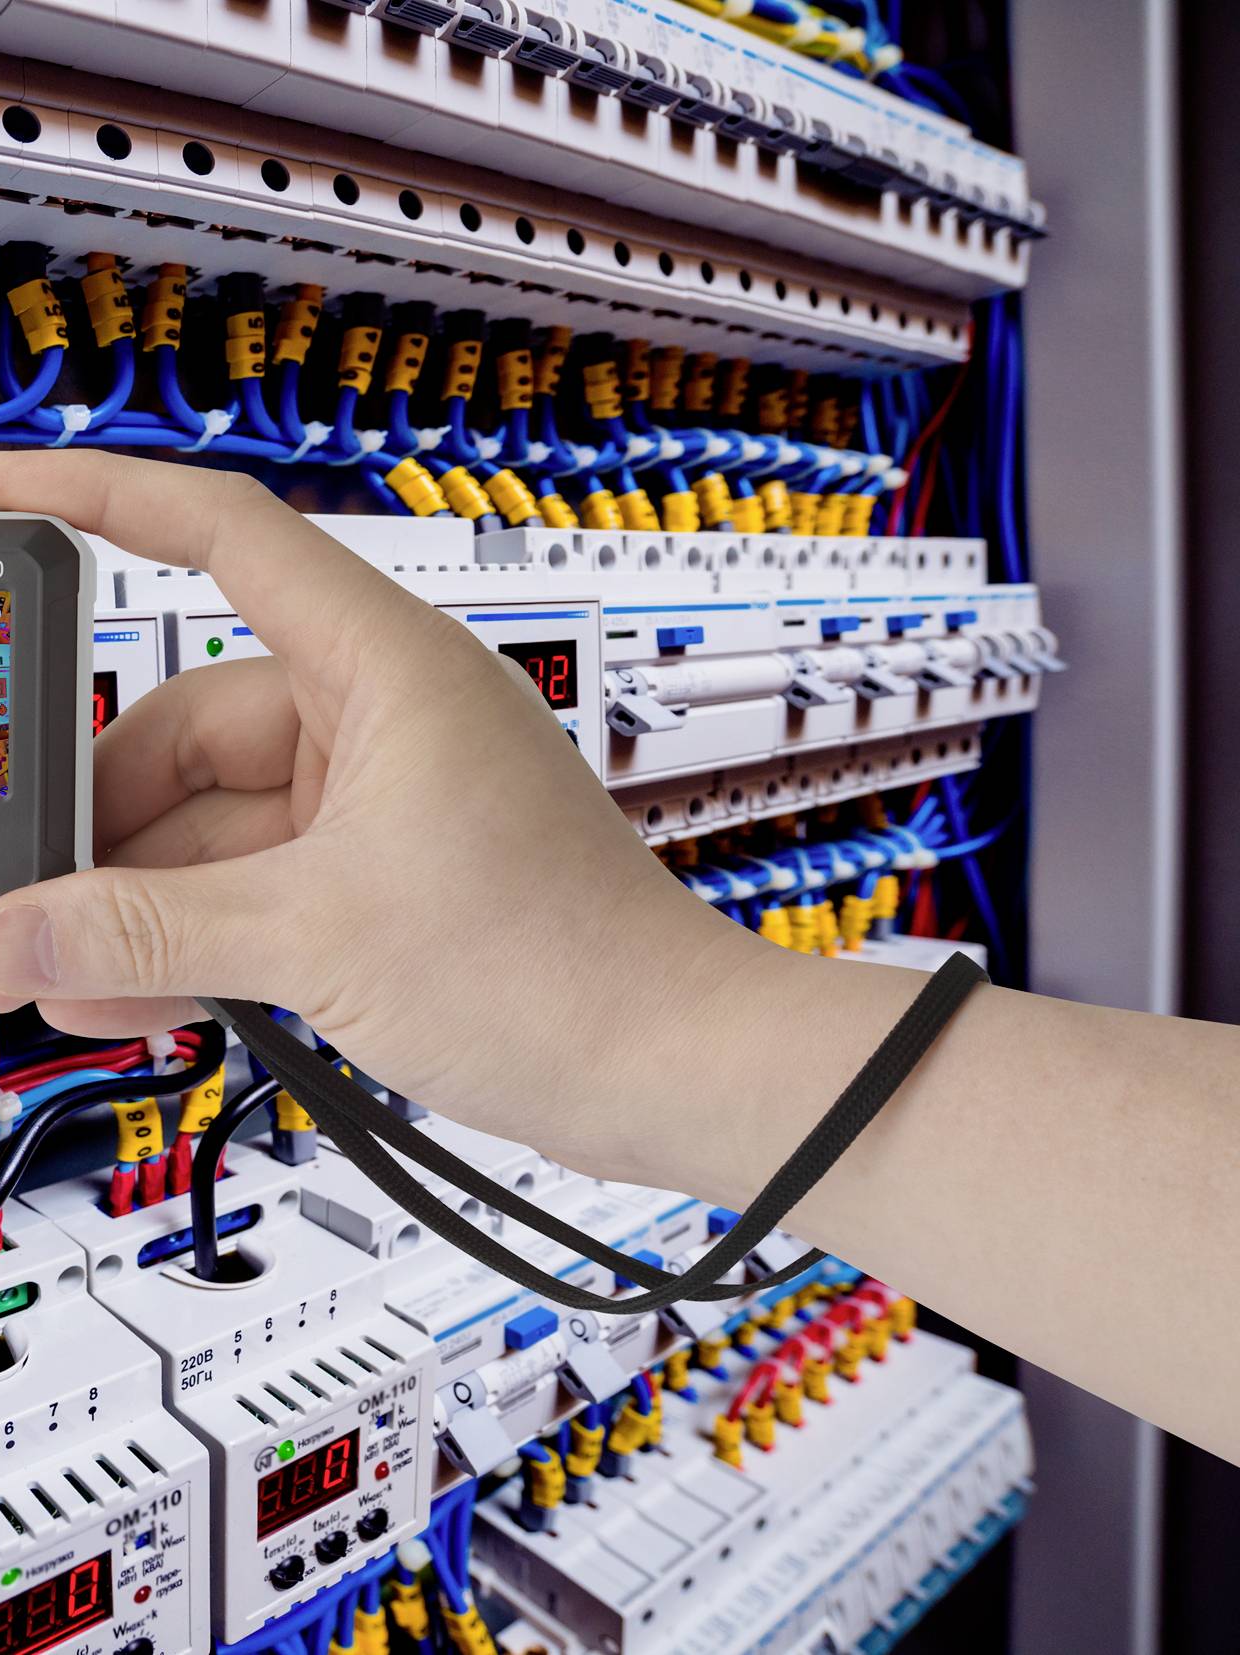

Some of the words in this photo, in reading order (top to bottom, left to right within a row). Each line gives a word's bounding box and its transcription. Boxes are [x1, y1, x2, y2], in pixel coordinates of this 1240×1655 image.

[125, 1109, 153, 1158] 008
[234, 1330, 243, 1343] 5
[265, 1317, 273, 1330] 6
[300, 1302, 307, 1315] 7
[330, 1289, 337, 1301] 8
[180, 1348, 214, 1374] 220В
[181, 1370, 213, 1391] 50Гц
[4, 1421, 14, 1436] 6
[49, 1402, 59, 1417] 7
[89, 1387, 98, 1401] 8
[105, 1490, 183, 1537] ОМ-110
[26, 1551, 75, 1580] Нагрузка
